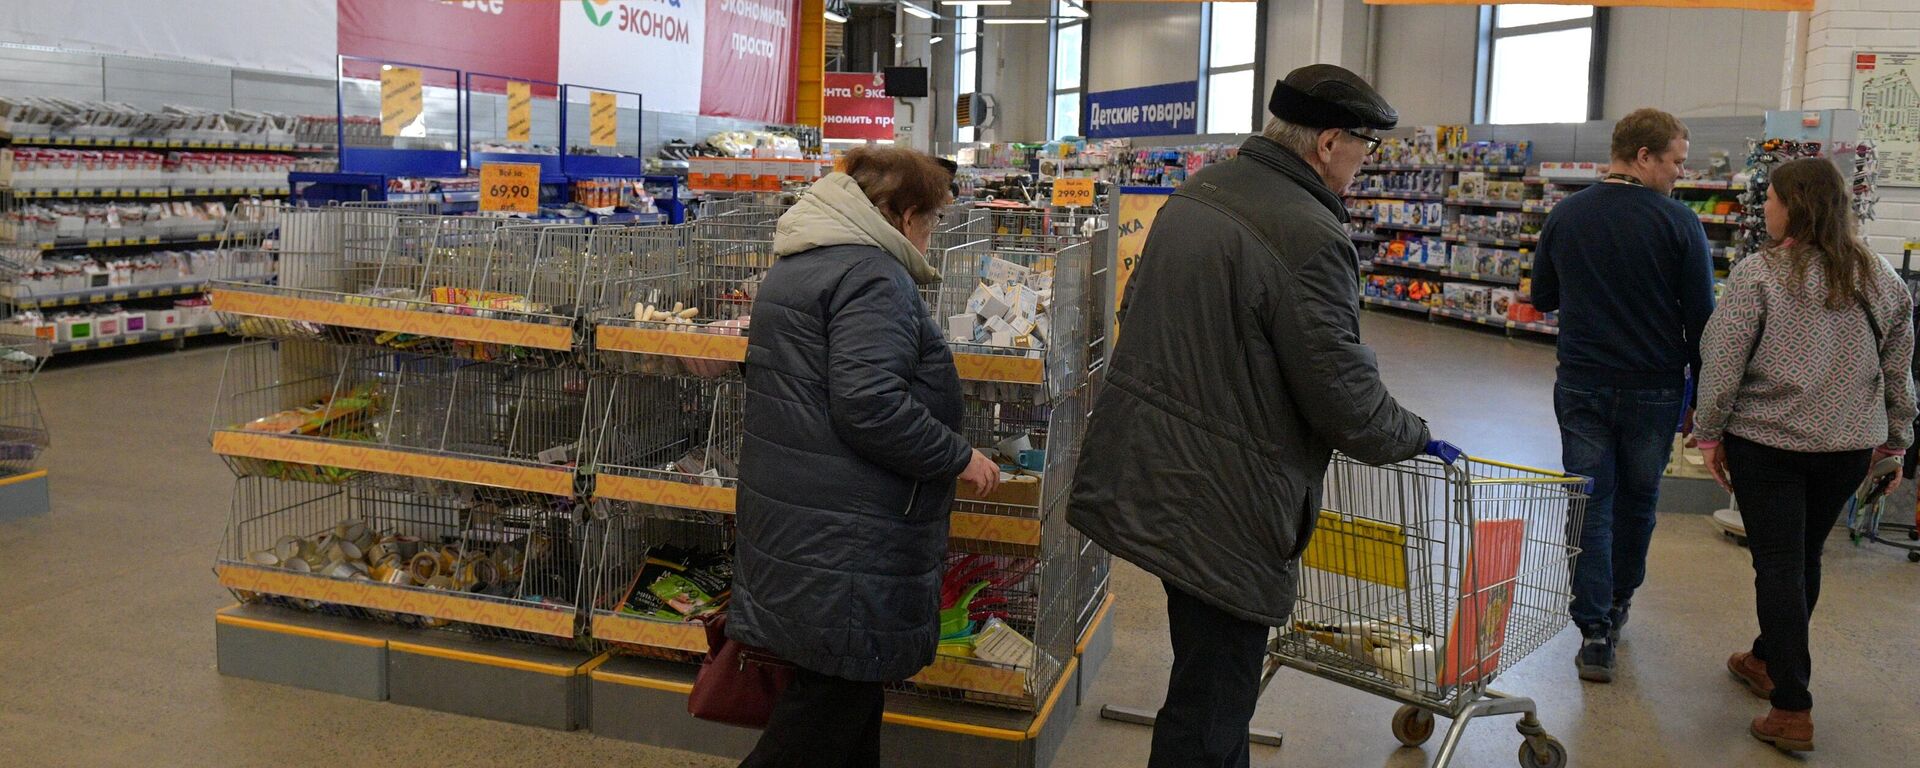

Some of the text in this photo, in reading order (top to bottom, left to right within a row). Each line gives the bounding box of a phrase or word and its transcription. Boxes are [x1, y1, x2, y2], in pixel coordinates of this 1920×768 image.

[618, 4, 689, 44] ЭКОНОМ
[732, 33, 774, 58] просто
[1090, 101, 1195, 130] Детские товары
[490, 184, 530, 202] 69,90
[1057, 189, 1090, 199] 299,90
